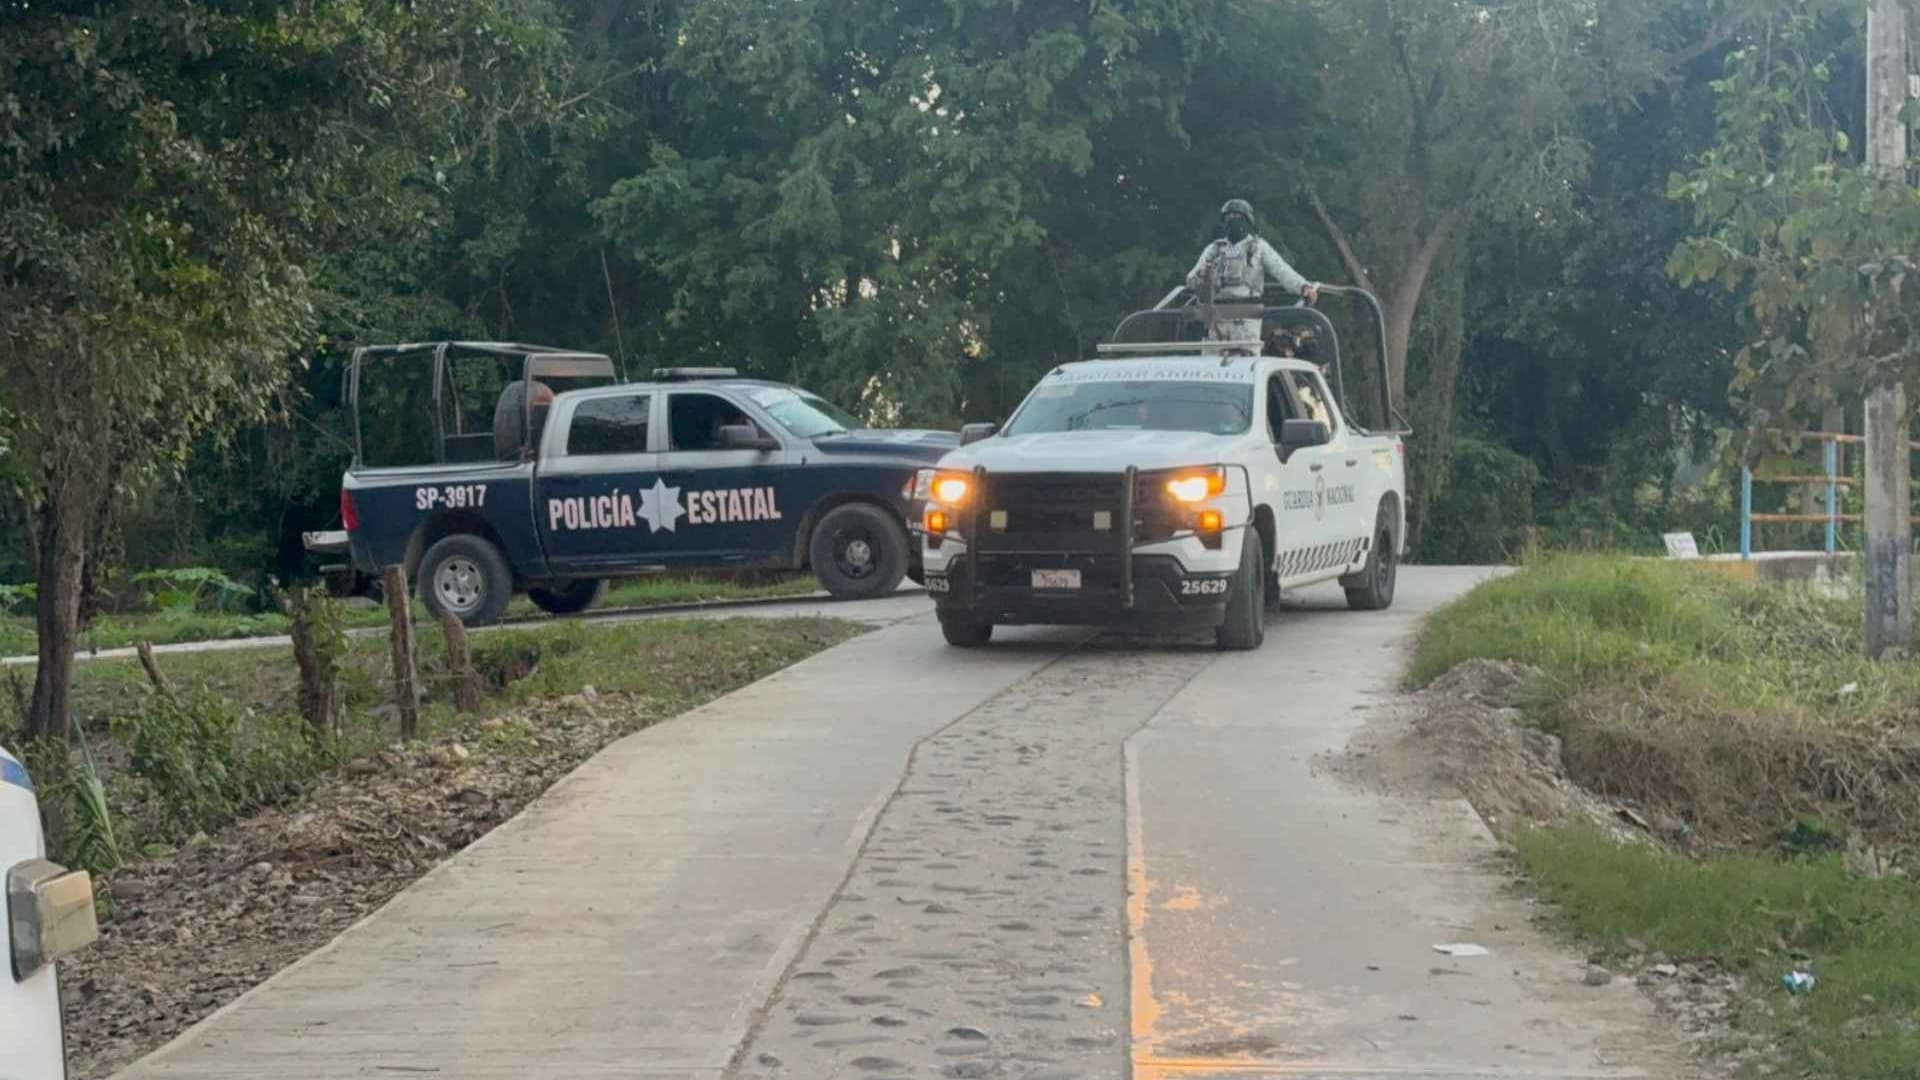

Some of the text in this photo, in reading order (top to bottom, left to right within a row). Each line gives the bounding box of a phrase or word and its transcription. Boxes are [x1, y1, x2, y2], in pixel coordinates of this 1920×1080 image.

[416, 484, 487, 510] SP-3917
[549, 486, 782, 531] POLICÍA ESTATAL
[1181, 579, 1228, 594] 25629
